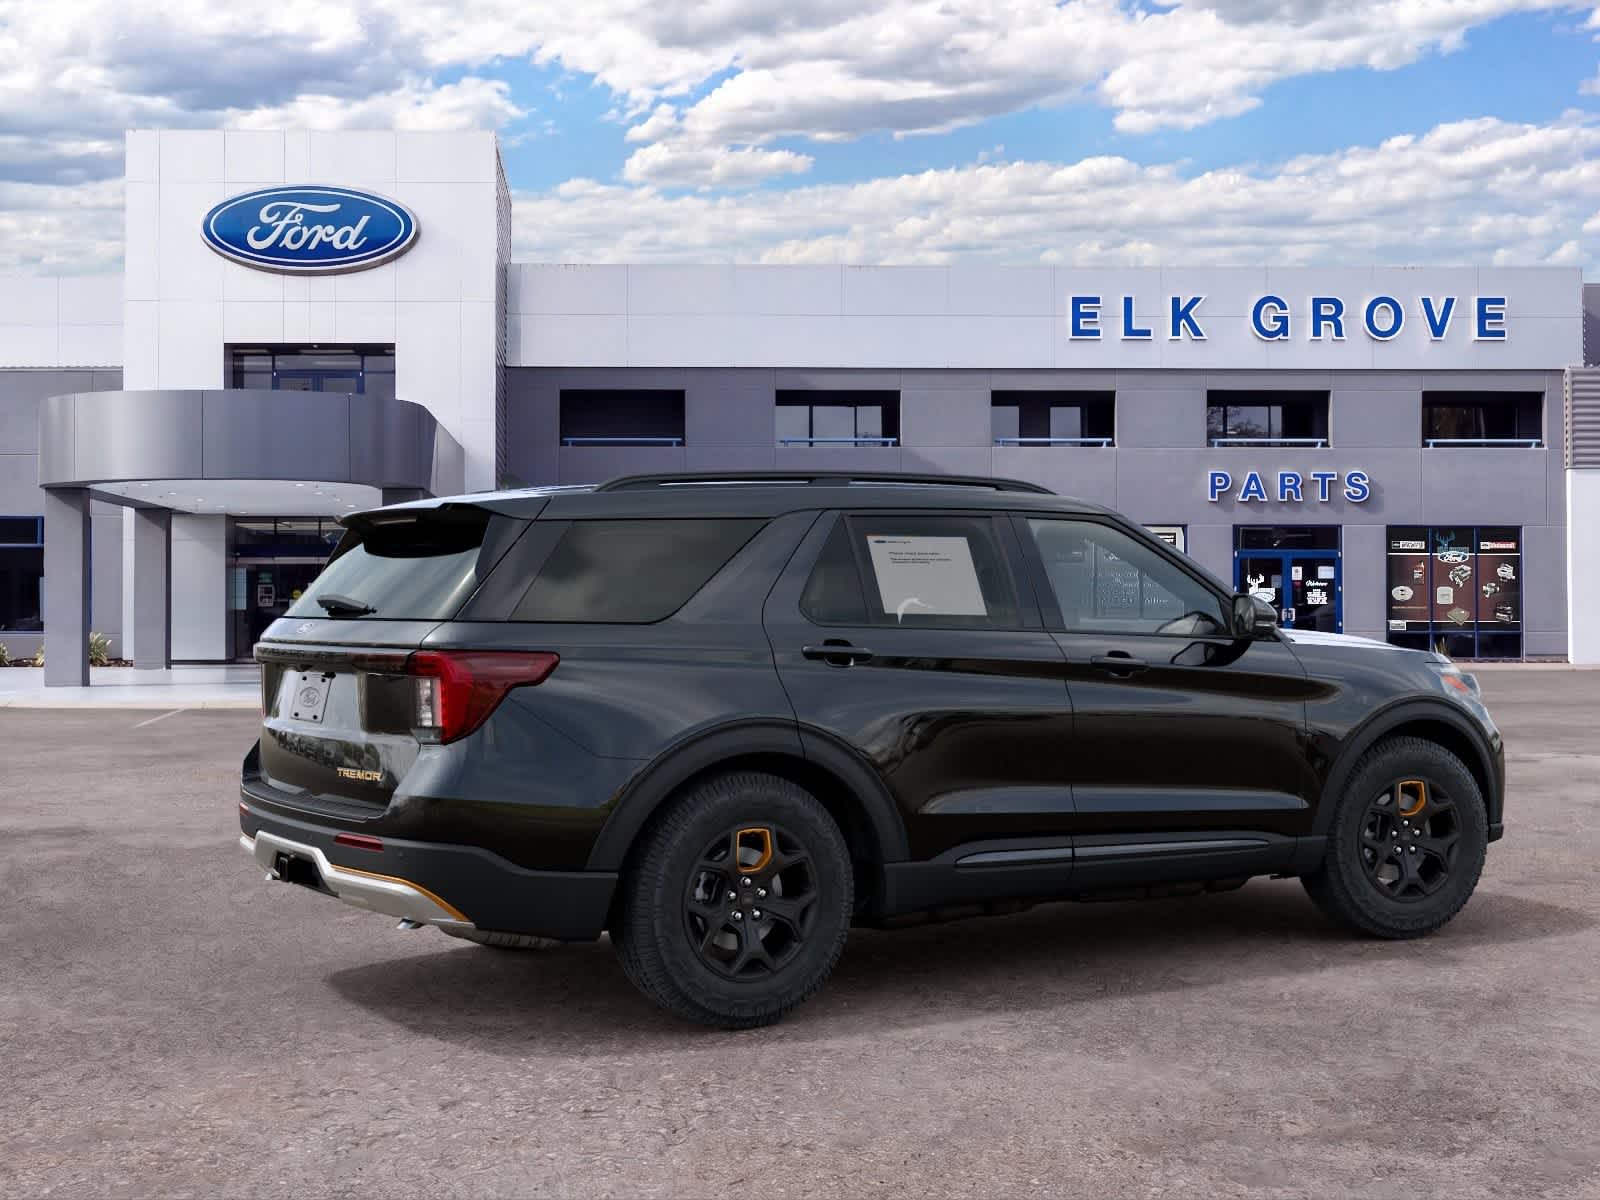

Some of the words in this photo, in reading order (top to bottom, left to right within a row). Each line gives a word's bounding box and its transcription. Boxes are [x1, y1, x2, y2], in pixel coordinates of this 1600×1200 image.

[246, 201, 371, 250] Ford
[1069, 295, 1208, 341] ELK
[1250, 294, 1508, 341] GROVE
[1207, 470, 1370, 502] PARTS
[336, 767, 384, 781] TREMOR
